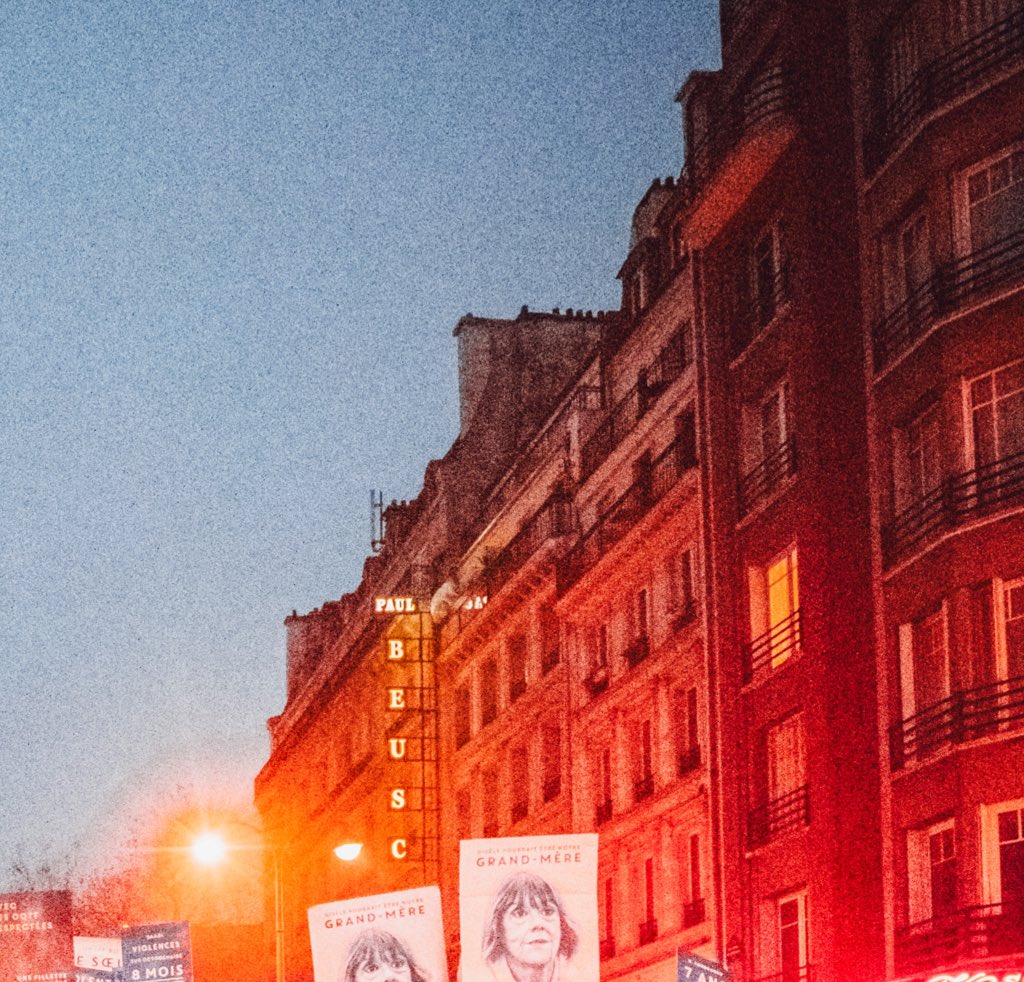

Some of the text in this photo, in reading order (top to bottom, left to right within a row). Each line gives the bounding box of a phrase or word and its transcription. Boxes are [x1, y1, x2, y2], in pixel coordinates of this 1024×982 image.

[375, 598, 415, 612] PAUL
[388, 640, 407, 858] BEUSC
[476, 851, 582, 867] GRAND-MÈRE
[324, 905, 426, 929] GRAND-MÈRE
[131, 941, 180, 953] VIOLENCES
[131, 965, 184, 980] 8 MOIS
[684, 966, 693, 978] 7
